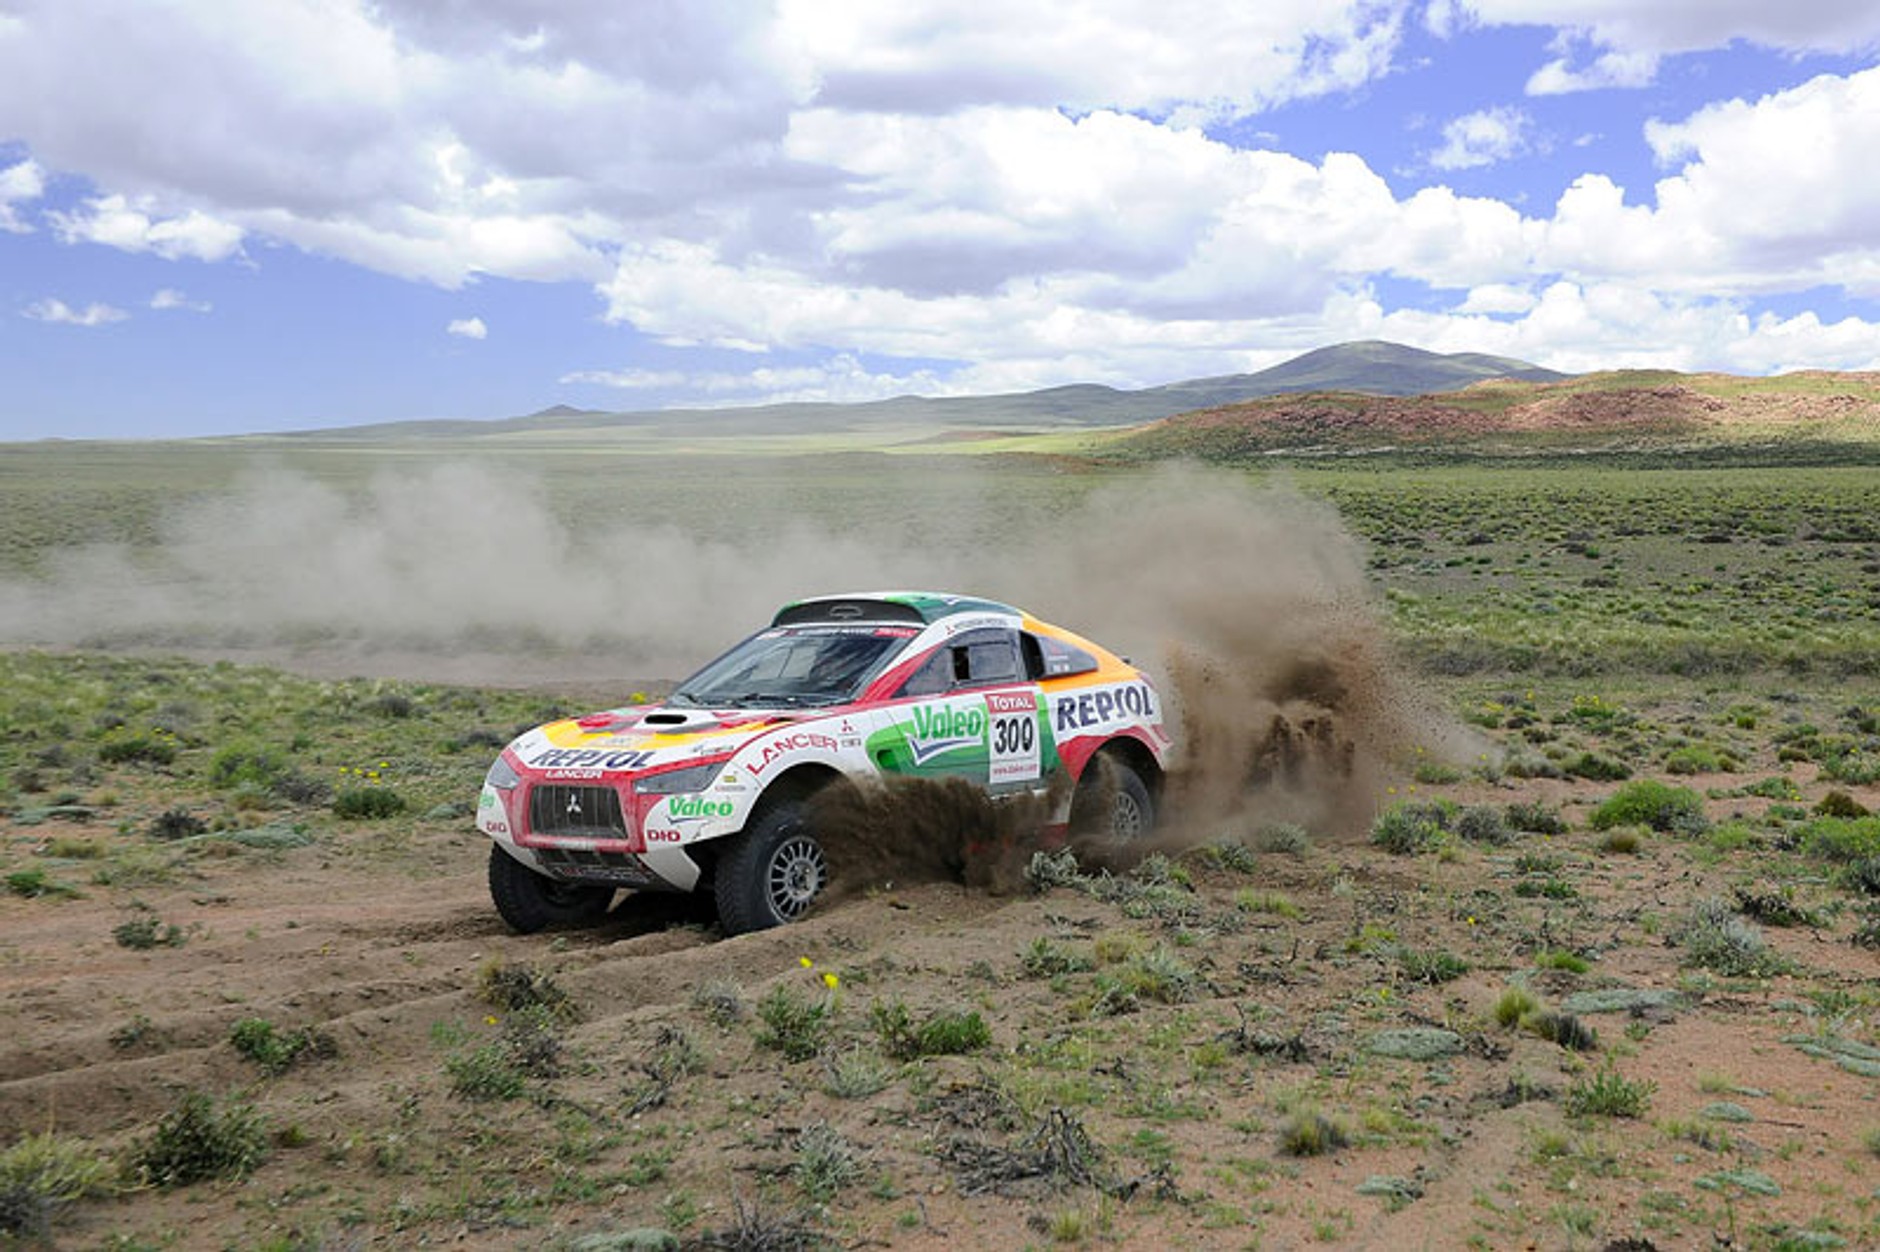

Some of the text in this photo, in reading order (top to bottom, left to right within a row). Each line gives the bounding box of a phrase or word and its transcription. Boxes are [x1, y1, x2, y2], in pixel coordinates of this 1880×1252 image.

[990, 694, 1033, 709] TOTAL
[1057, 685, 1154, 732] REPSOL
[912, 704, 982, 739] Valeo
[994, 716, 1033, 754] 300
[529, 748, 657, 768] REPSOL
[746, 733, 838, 776] LANCER
[545, 768, 603, 779] LANCER
[668, 796, 734, 817] Valeo
